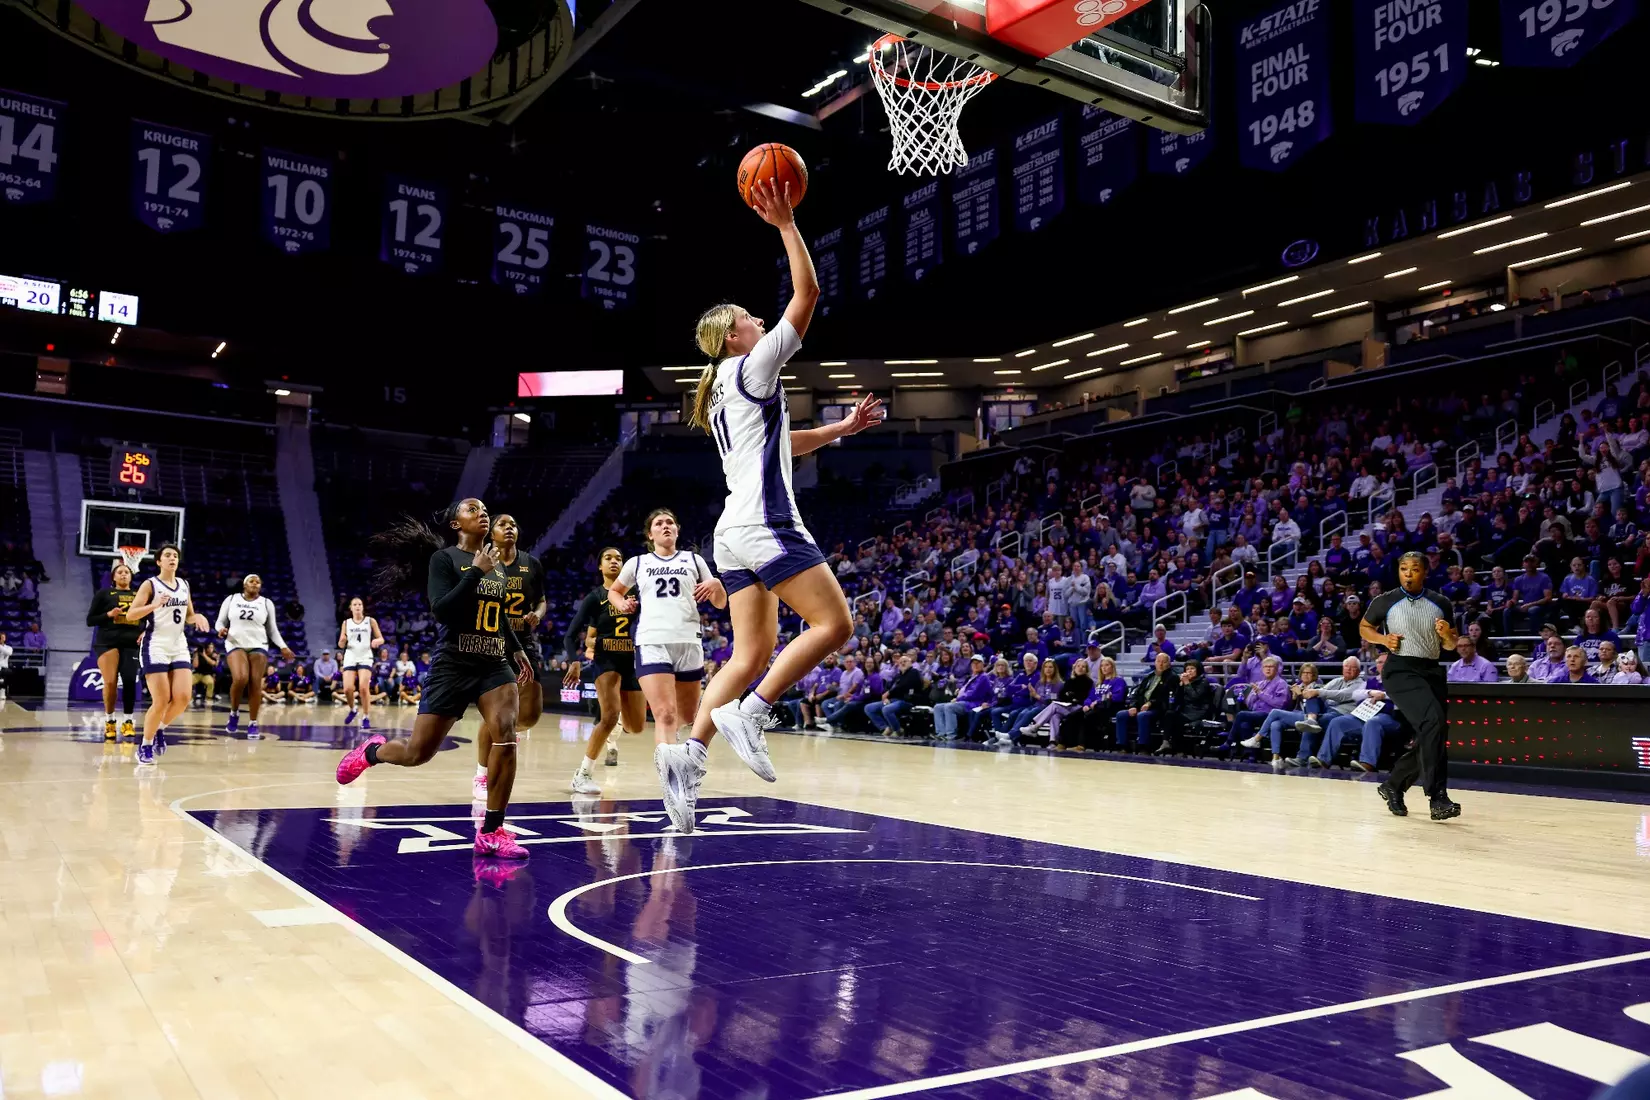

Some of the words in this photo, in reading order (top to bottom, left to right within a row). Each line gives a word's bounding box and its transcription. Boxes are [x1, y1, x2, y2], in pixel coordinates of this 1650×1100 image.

[1240, 0, 1320, 45] K-STATE
[1374, 0, 1441, 29] FINA
[1268, 12, 1316, 40] BASKETBALL
[1374, 4, 1443, 51] FOUR
[1251, 42, 1311, 83] FINAL
[1374, 43, 1449, 97] 1951
[1251, 62, 1309, 103] FOUR
[0, 97, 57, 120] URRELL
[1015, 118, 1059, 148] K-STATE
[1248, 99, 1315, 146] 1948
[143, 129, 199, 151] KRUGER
[1081, 128, 1104, 146] SWEET
[1186, 131, 1206, 145] 1975
[1160, 141, 1179, 156] 1961
[267, 156, 329, 178] WILLIAMS
[1013, 160, 1034, 176] SWEET
[1034, 148, 1060, 168] SIXTEEN
[1571, 137, 1650, 187] ST
[0, 172, 42, 189] 962-64
[137, 148, 202, 203] 12
[267, 174, 326, 225] 10
[398, 184, 437, 201] EVANS
[904, 181, 938, 207] K-STATE
[143, 201, 190, 218] 1971-74
[496, 206, 555, 226] BLACKMAN
[857, 205, 889, 229] K-STATE
[910, 208, 929, 223] NCAA
[273, 225, 315, 241] 1972-76
[388, 199, 442, 249] 12
[586, 224, 640, 244] RICHMOND
[393, 248, 433, 263] 1974-78
[497, 222, 549, 270] 25
[587, 240, 636, 286] 23
[504, 269, 541, 284] 1977-81
[26, 290, 51, 306] 20
[70, 288, 89, 299] 6:56
[108, 303, 129, 317] 14
[384, 385, 407, 404] 15
[713, 406, 733, 456] 11
[125, 452, 151, 466] 6:56
[120, 462, 146, 484] 26
[646, 566, 688, 577] Wildcats
[476, 577, 504, 598] WEST
[505, 576, 523, 591] EST
[655, 576, 681, 599] 23
[172, 609, 182, 625] 6
[239, 609, 254, 621] 22
[475, 599, 501, 633] 10
[356, 633, 362, 643] 4
[614, 616, 629, 638] 2
